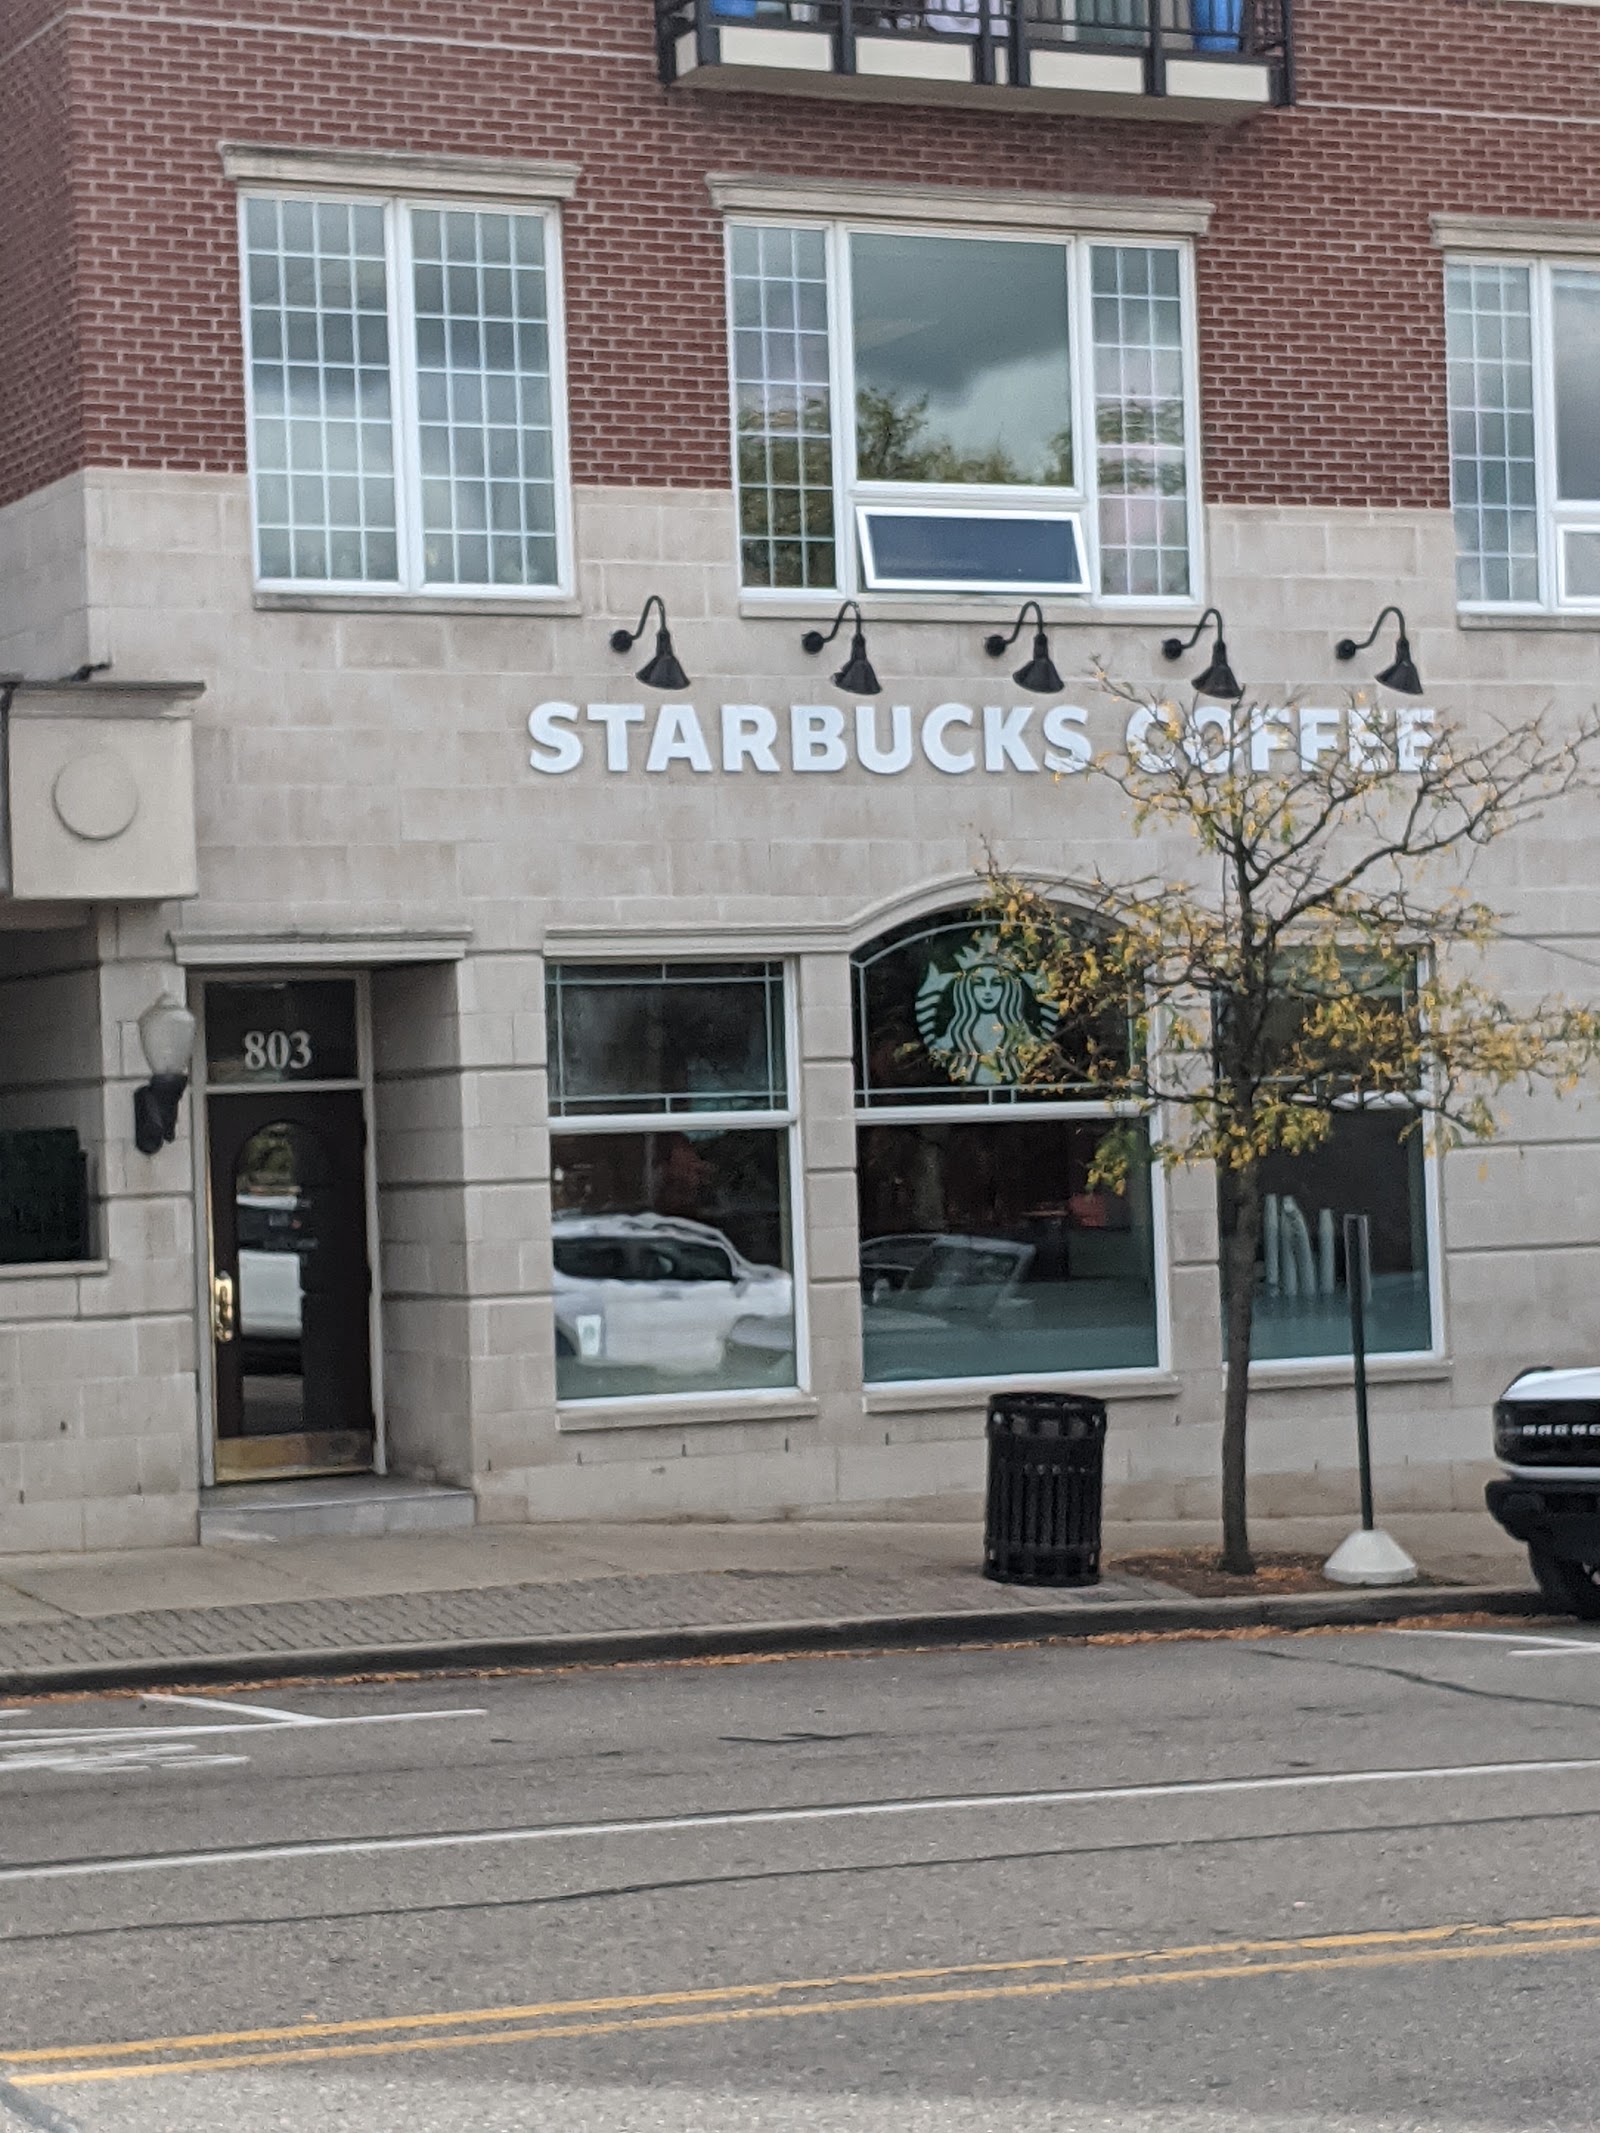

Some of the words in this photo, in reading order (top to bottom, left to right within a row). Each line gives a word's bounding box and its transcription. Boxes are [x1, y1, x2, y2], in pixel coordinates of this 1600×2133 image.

[527, 700, 1093, 774] STARBUCKS
[1125, 704, 1441, 774] COFFEE
[243, 1029, 312, 1070] 803
